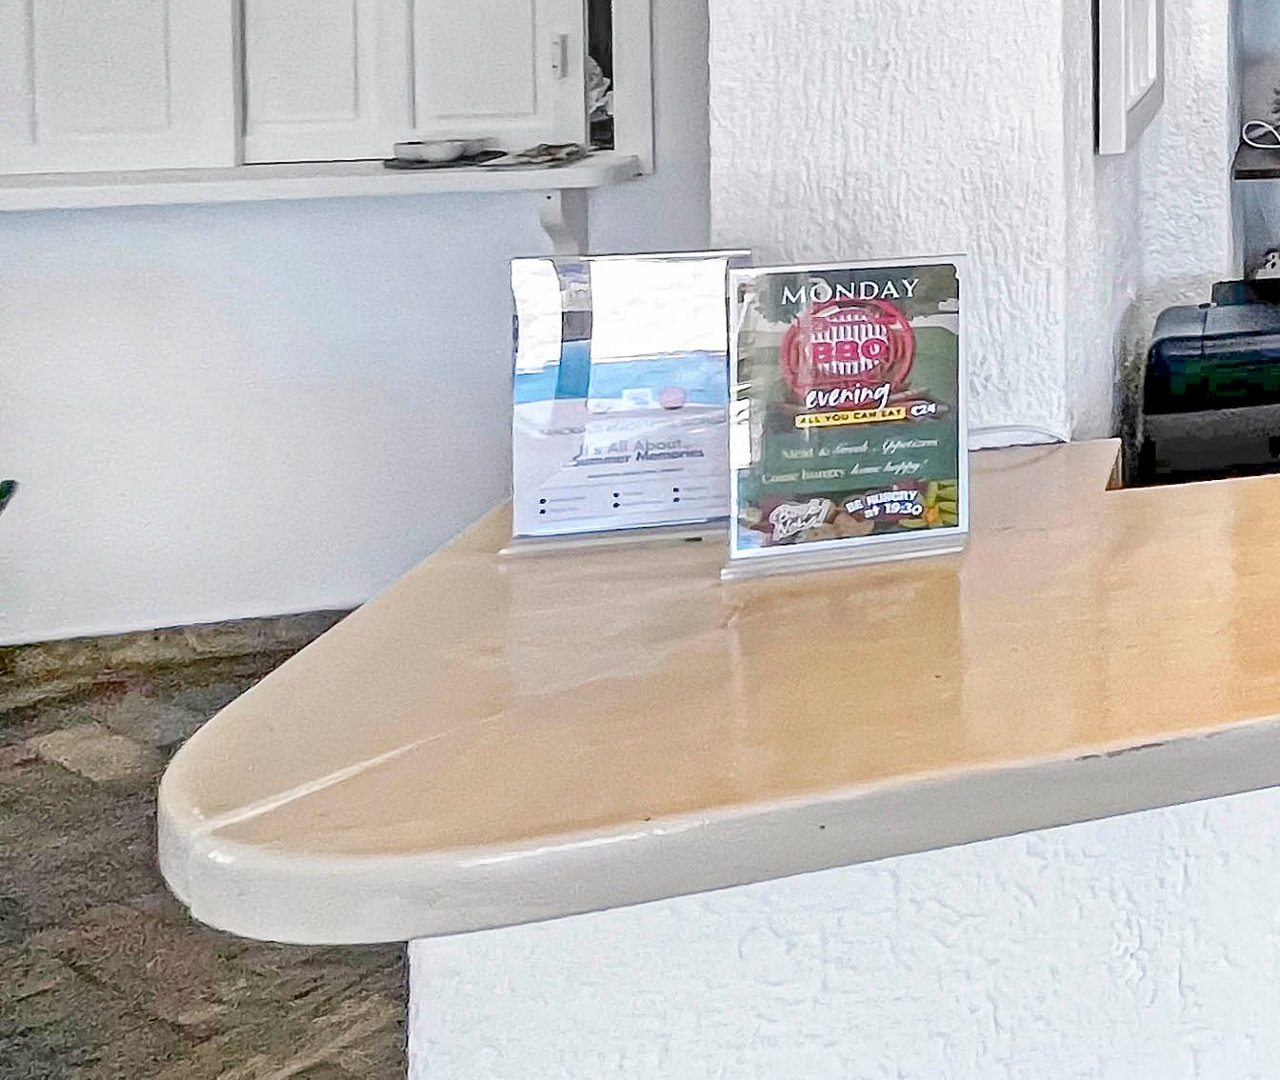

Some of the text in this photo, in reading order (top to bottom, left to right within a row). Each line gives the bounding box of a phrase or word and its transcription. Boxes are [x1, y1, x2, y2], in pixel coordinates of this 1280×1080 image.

[781, 278, 919, 305] MONDAY
[812, 338, 889, 361] BBQ
[805, 383, 890, 410] evening
[825, 413, 849, 422] YOU
